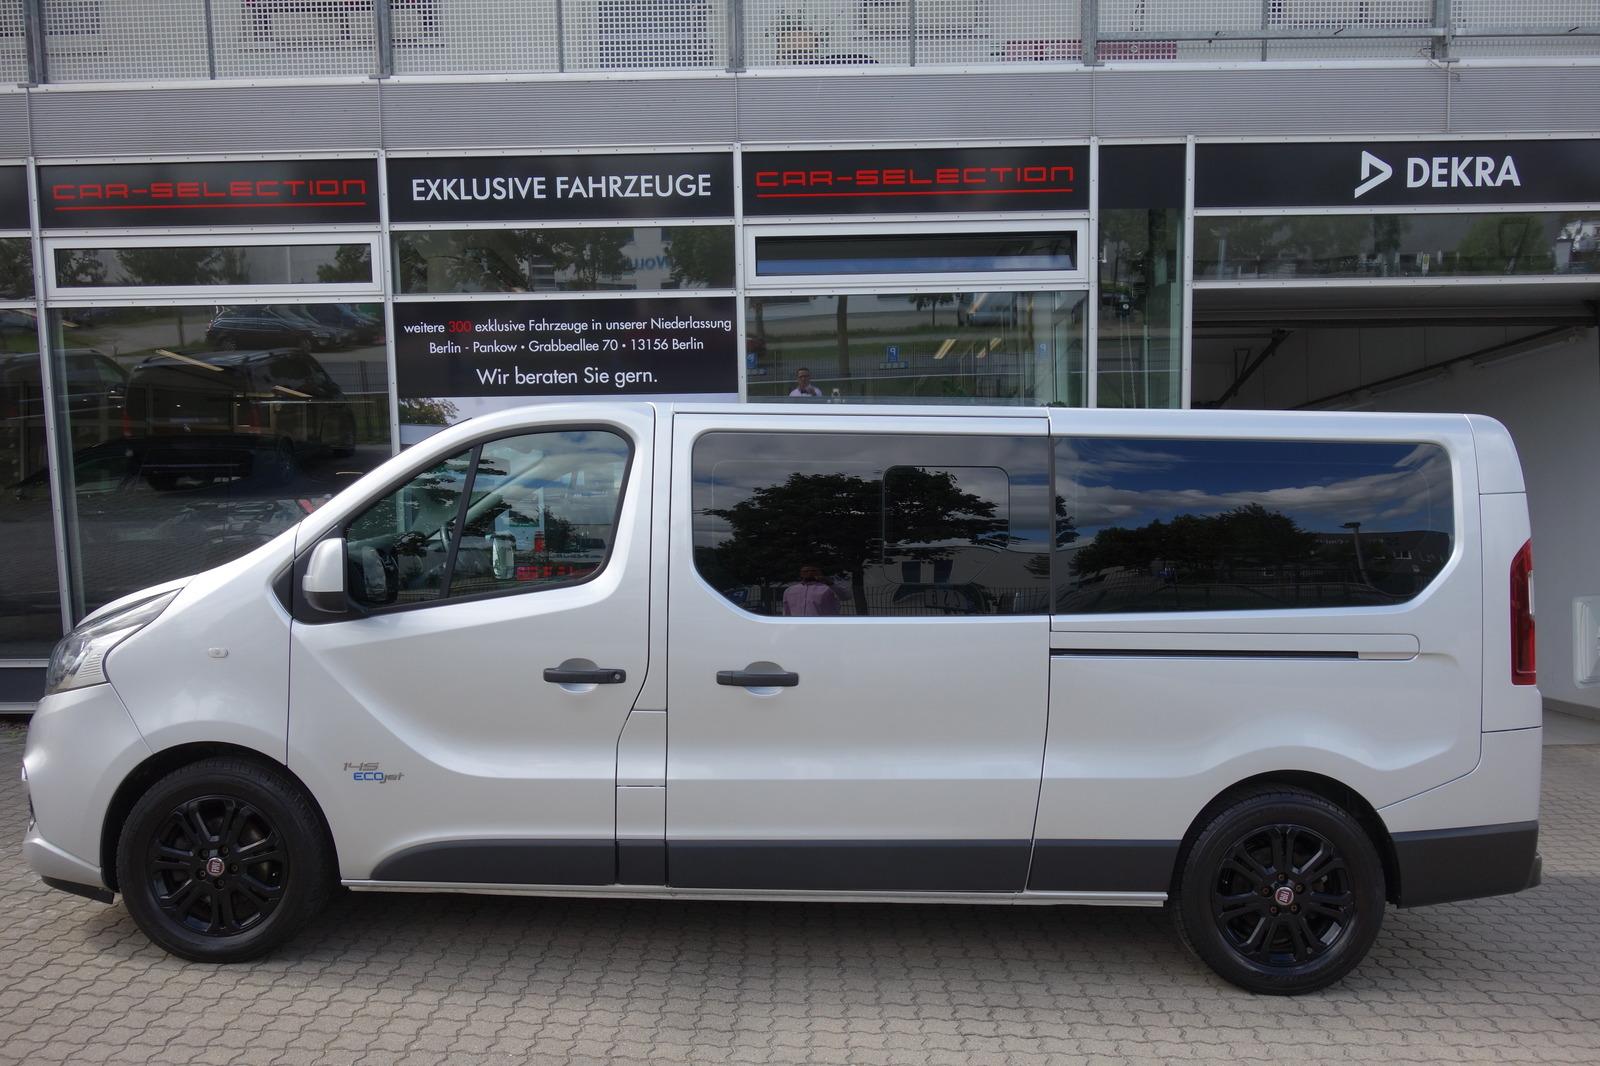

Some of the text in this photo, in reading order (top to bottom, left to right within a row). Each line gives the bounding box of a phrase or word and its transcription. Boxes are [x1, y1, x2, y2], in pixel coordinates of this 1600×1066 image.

[754, 165, 1075, 187] CAR-SELECTION
[1406, 155, 1521, 190] DEKRA
[52, 179, 368, 200] CAR-SELECTION
[412, 173, 711, 201] EXKLUSIVE FAHRZEUGE
[403, 315, 732, 335] weitere 300 exklusive Fahrzeuge in unserer Niederlassung
[429, 340, 462, 354] Berlin
[473, 340, 518, 353] Pankow
[528, 338, 600, 352] Grabbeallee
[603, 338, 619, 351] 70
[631, 338, 669, 351] 13156
[672, 337, 704, 350] Berlin
[476, 365, 658, 388] Wir beraten Sie gern.
